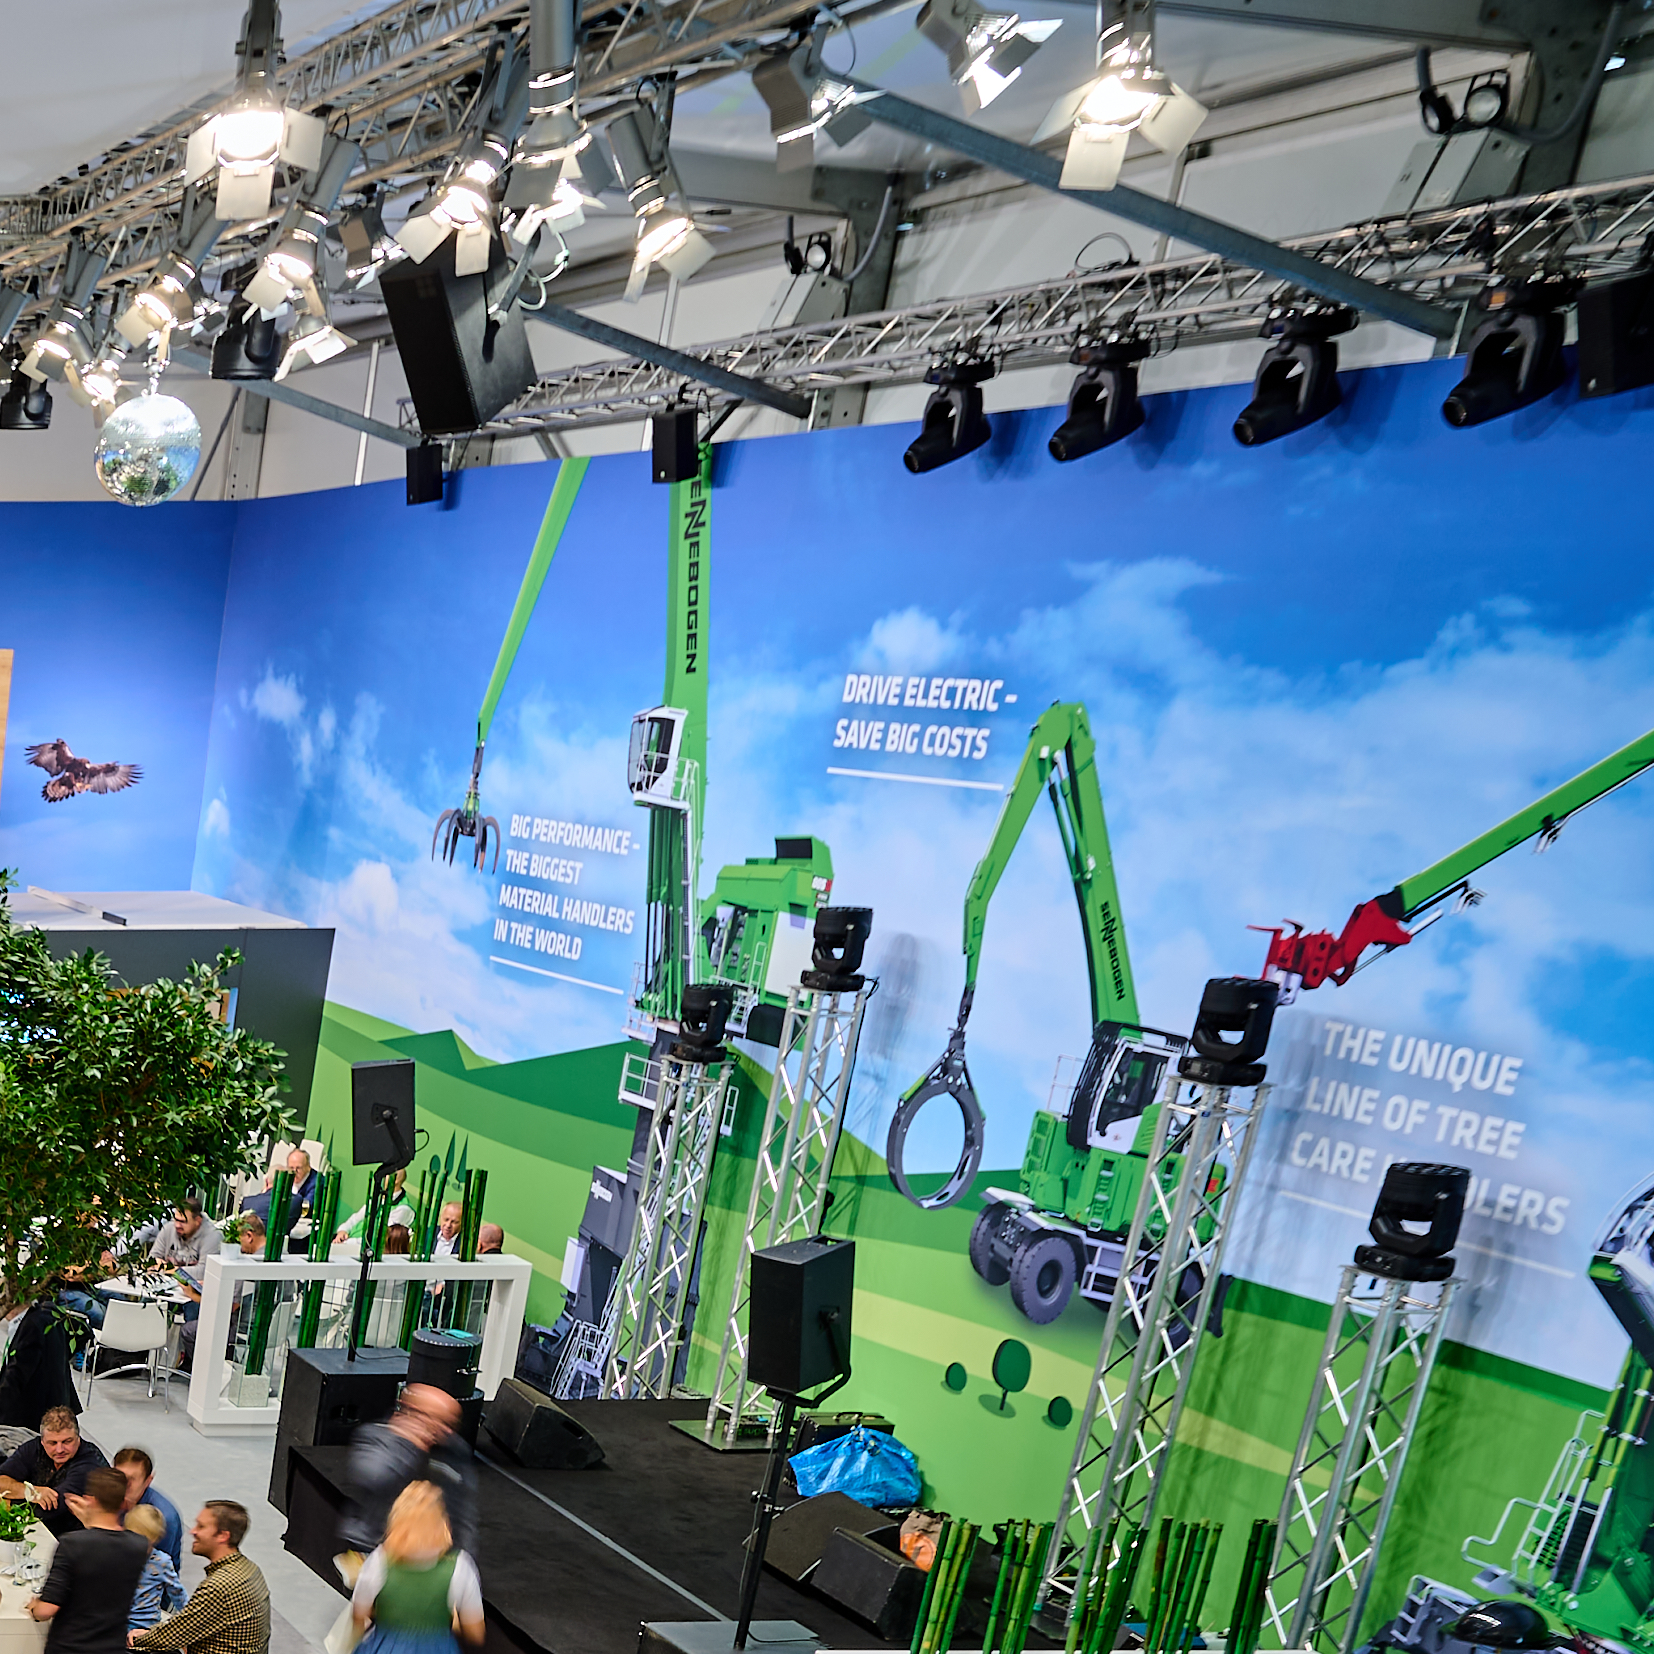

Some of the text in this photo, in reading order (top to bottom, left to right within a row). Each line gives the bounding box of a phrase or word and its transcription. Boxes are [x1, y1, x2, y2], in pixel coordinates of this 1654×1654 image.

[842, 673, 903, 706] DRIVE
[903, 676, 1004, 712] ELECTRIC
[833, 718, 990, 760] SAVE BIG COSTS
[510, 814, 531, 839] BIG
[532, 817, 631, 855] PERFORMANCE
[506, 849, 583, 885] THE BIGGEST
[499, 884, 635, 935] MATERIAL HANDLERS
[494, 918, 582, 960] IN THE WORLD
[1100, 900, 1126, 1001] SENNEBOGEN
[1323, 1020, 1523, 1097] THE UNIQUE
[1304, 1076, 1527, 1160] LINE OF TREE
[1290, 1131, 1377, 1184] CARE
